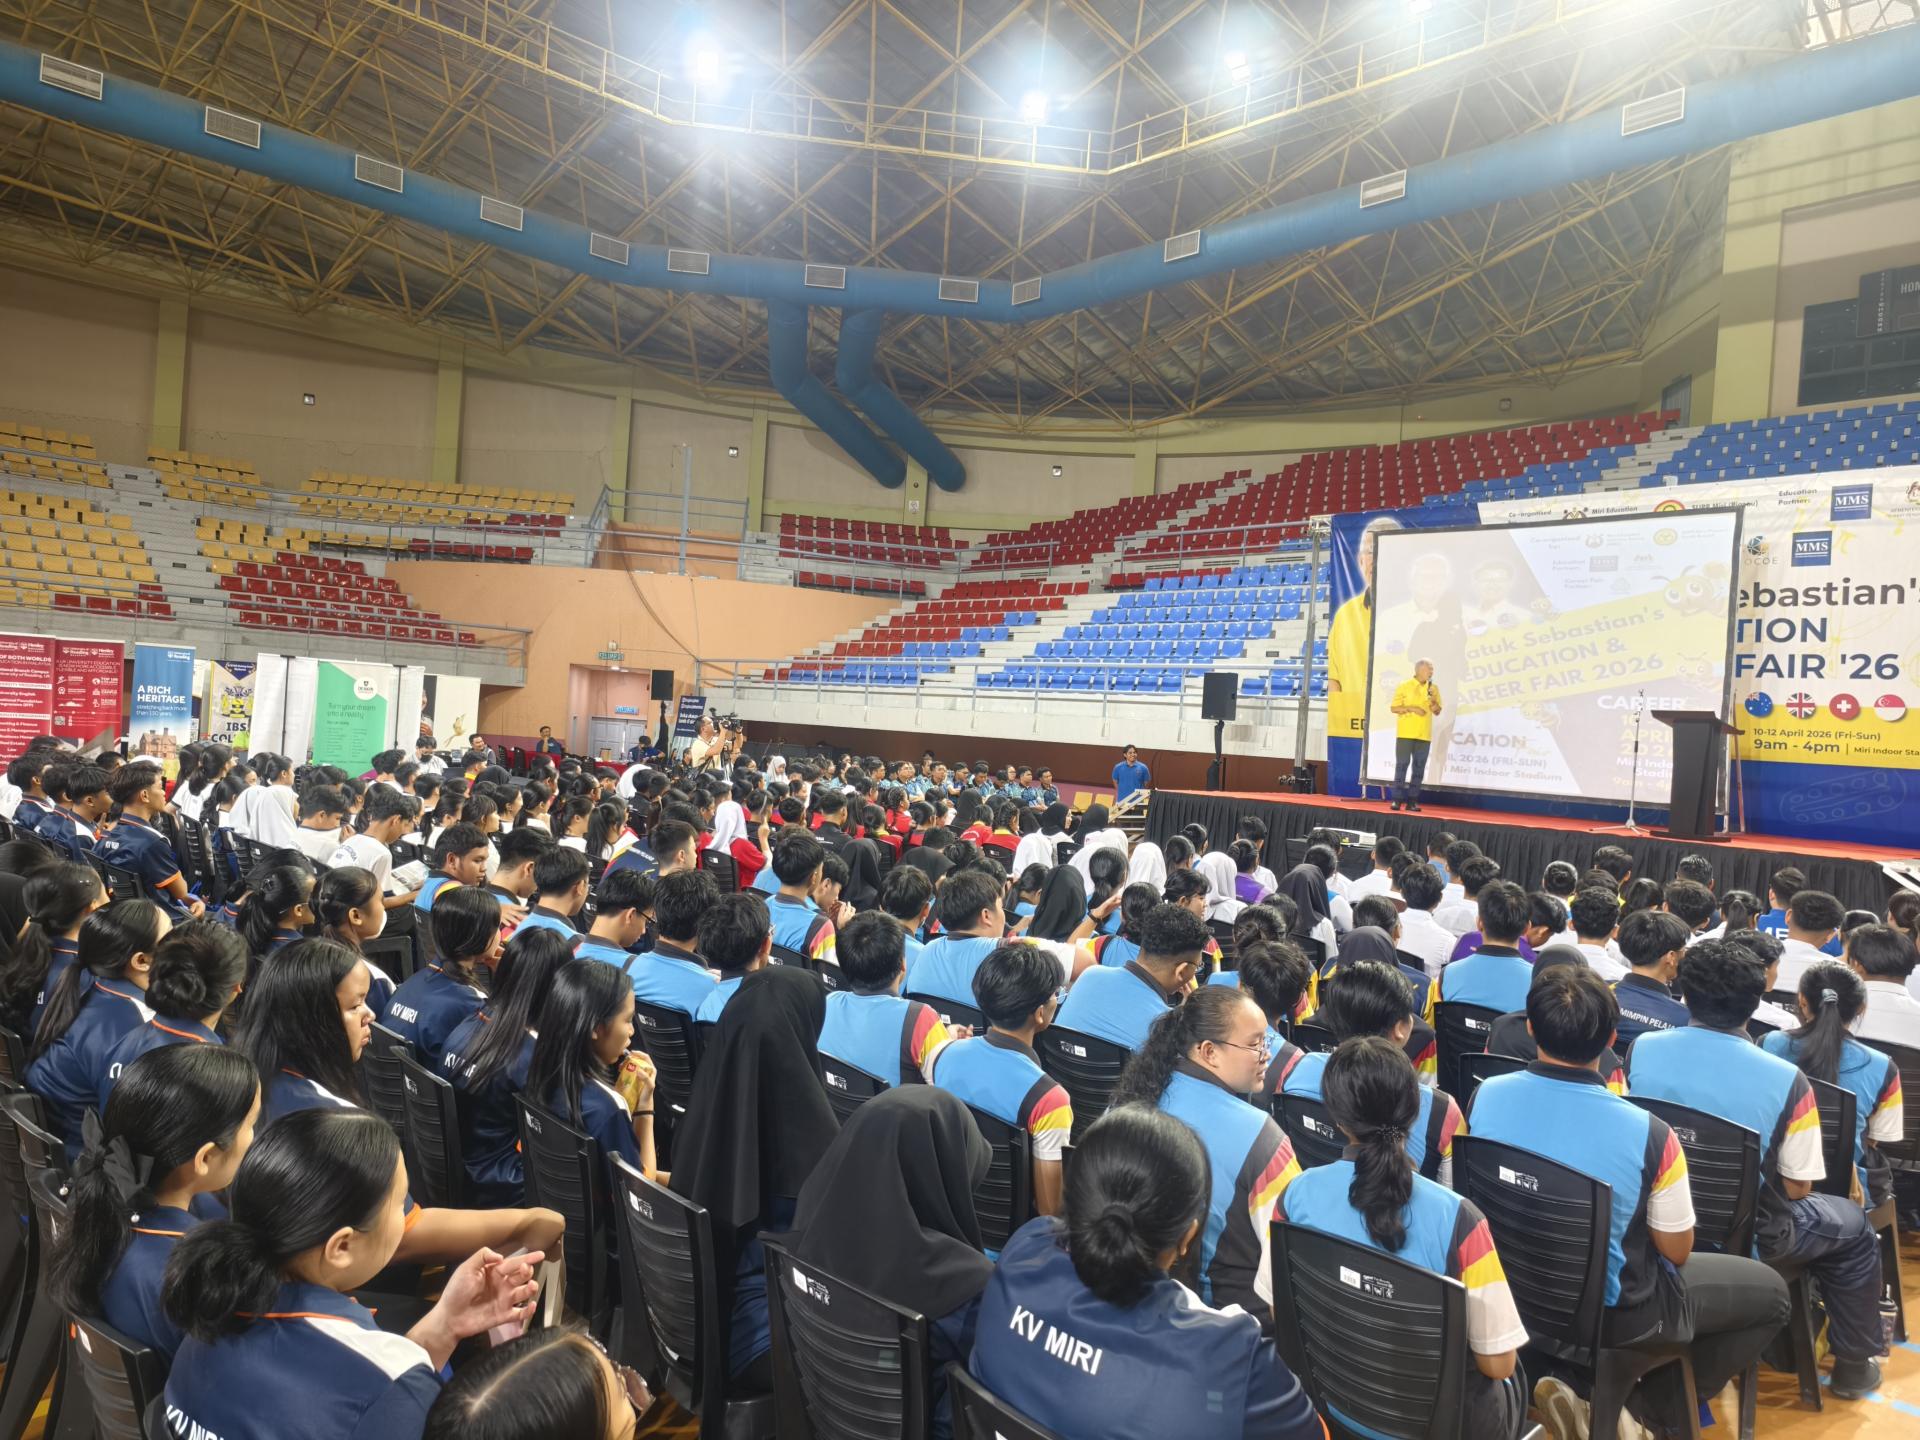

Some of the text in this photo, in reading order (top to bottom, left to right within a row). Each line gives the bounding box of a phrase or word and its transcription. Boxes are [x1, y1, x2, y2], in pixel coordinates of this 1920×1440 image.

[1778, 488, 1817, 497] Education
[1834, 495, 1869, 506] MMS
[1606, 505, 1638, 514] Education
[1795, 541, 1829, 553] MMS
[1739, 577, 1920, 609] ebastian'
[1523, 606, 1664, 648] Sebastian's
[1463, 637, 1628, 682] EDUCATION &
[1735, 653, 1900, 680] FAIR '26
[1529, 668, 1585, 693] FAIR
[1592, 653, 1664, 681] 2026
[137, 685, 171, 694] A RICH
[137, 694, 186, 704] HERITAGE
[226, 722, 247, 732] IBS
[212, 733, 233, 743] COL
[1451, 732, 1526, 749] CATION
[1753, 728, 1881, 742] 10-12 April 2026 (Fri-Sun)
[1753, 738, 1788, 750] 9am
[1803, 740, 1840, 754] 4pm
[1854, 746, 1871, 754] Miri
[1873, 747, 1902, 756] Indoor
[1459, 754, 1489, 764] 2026
[1492, 755, 1548, 769] (FRI-SUN)
[1450, 765, 1563, 782] Miri Indoor Stadium
[1635, 767, 1673, 778] Stadi
[390, 1002, 418, 1024] KV MIRI
[1620, 1007, 1649, 1024] MIMPIN
[1009, 1304, 1103, 1375] KV MIRI
